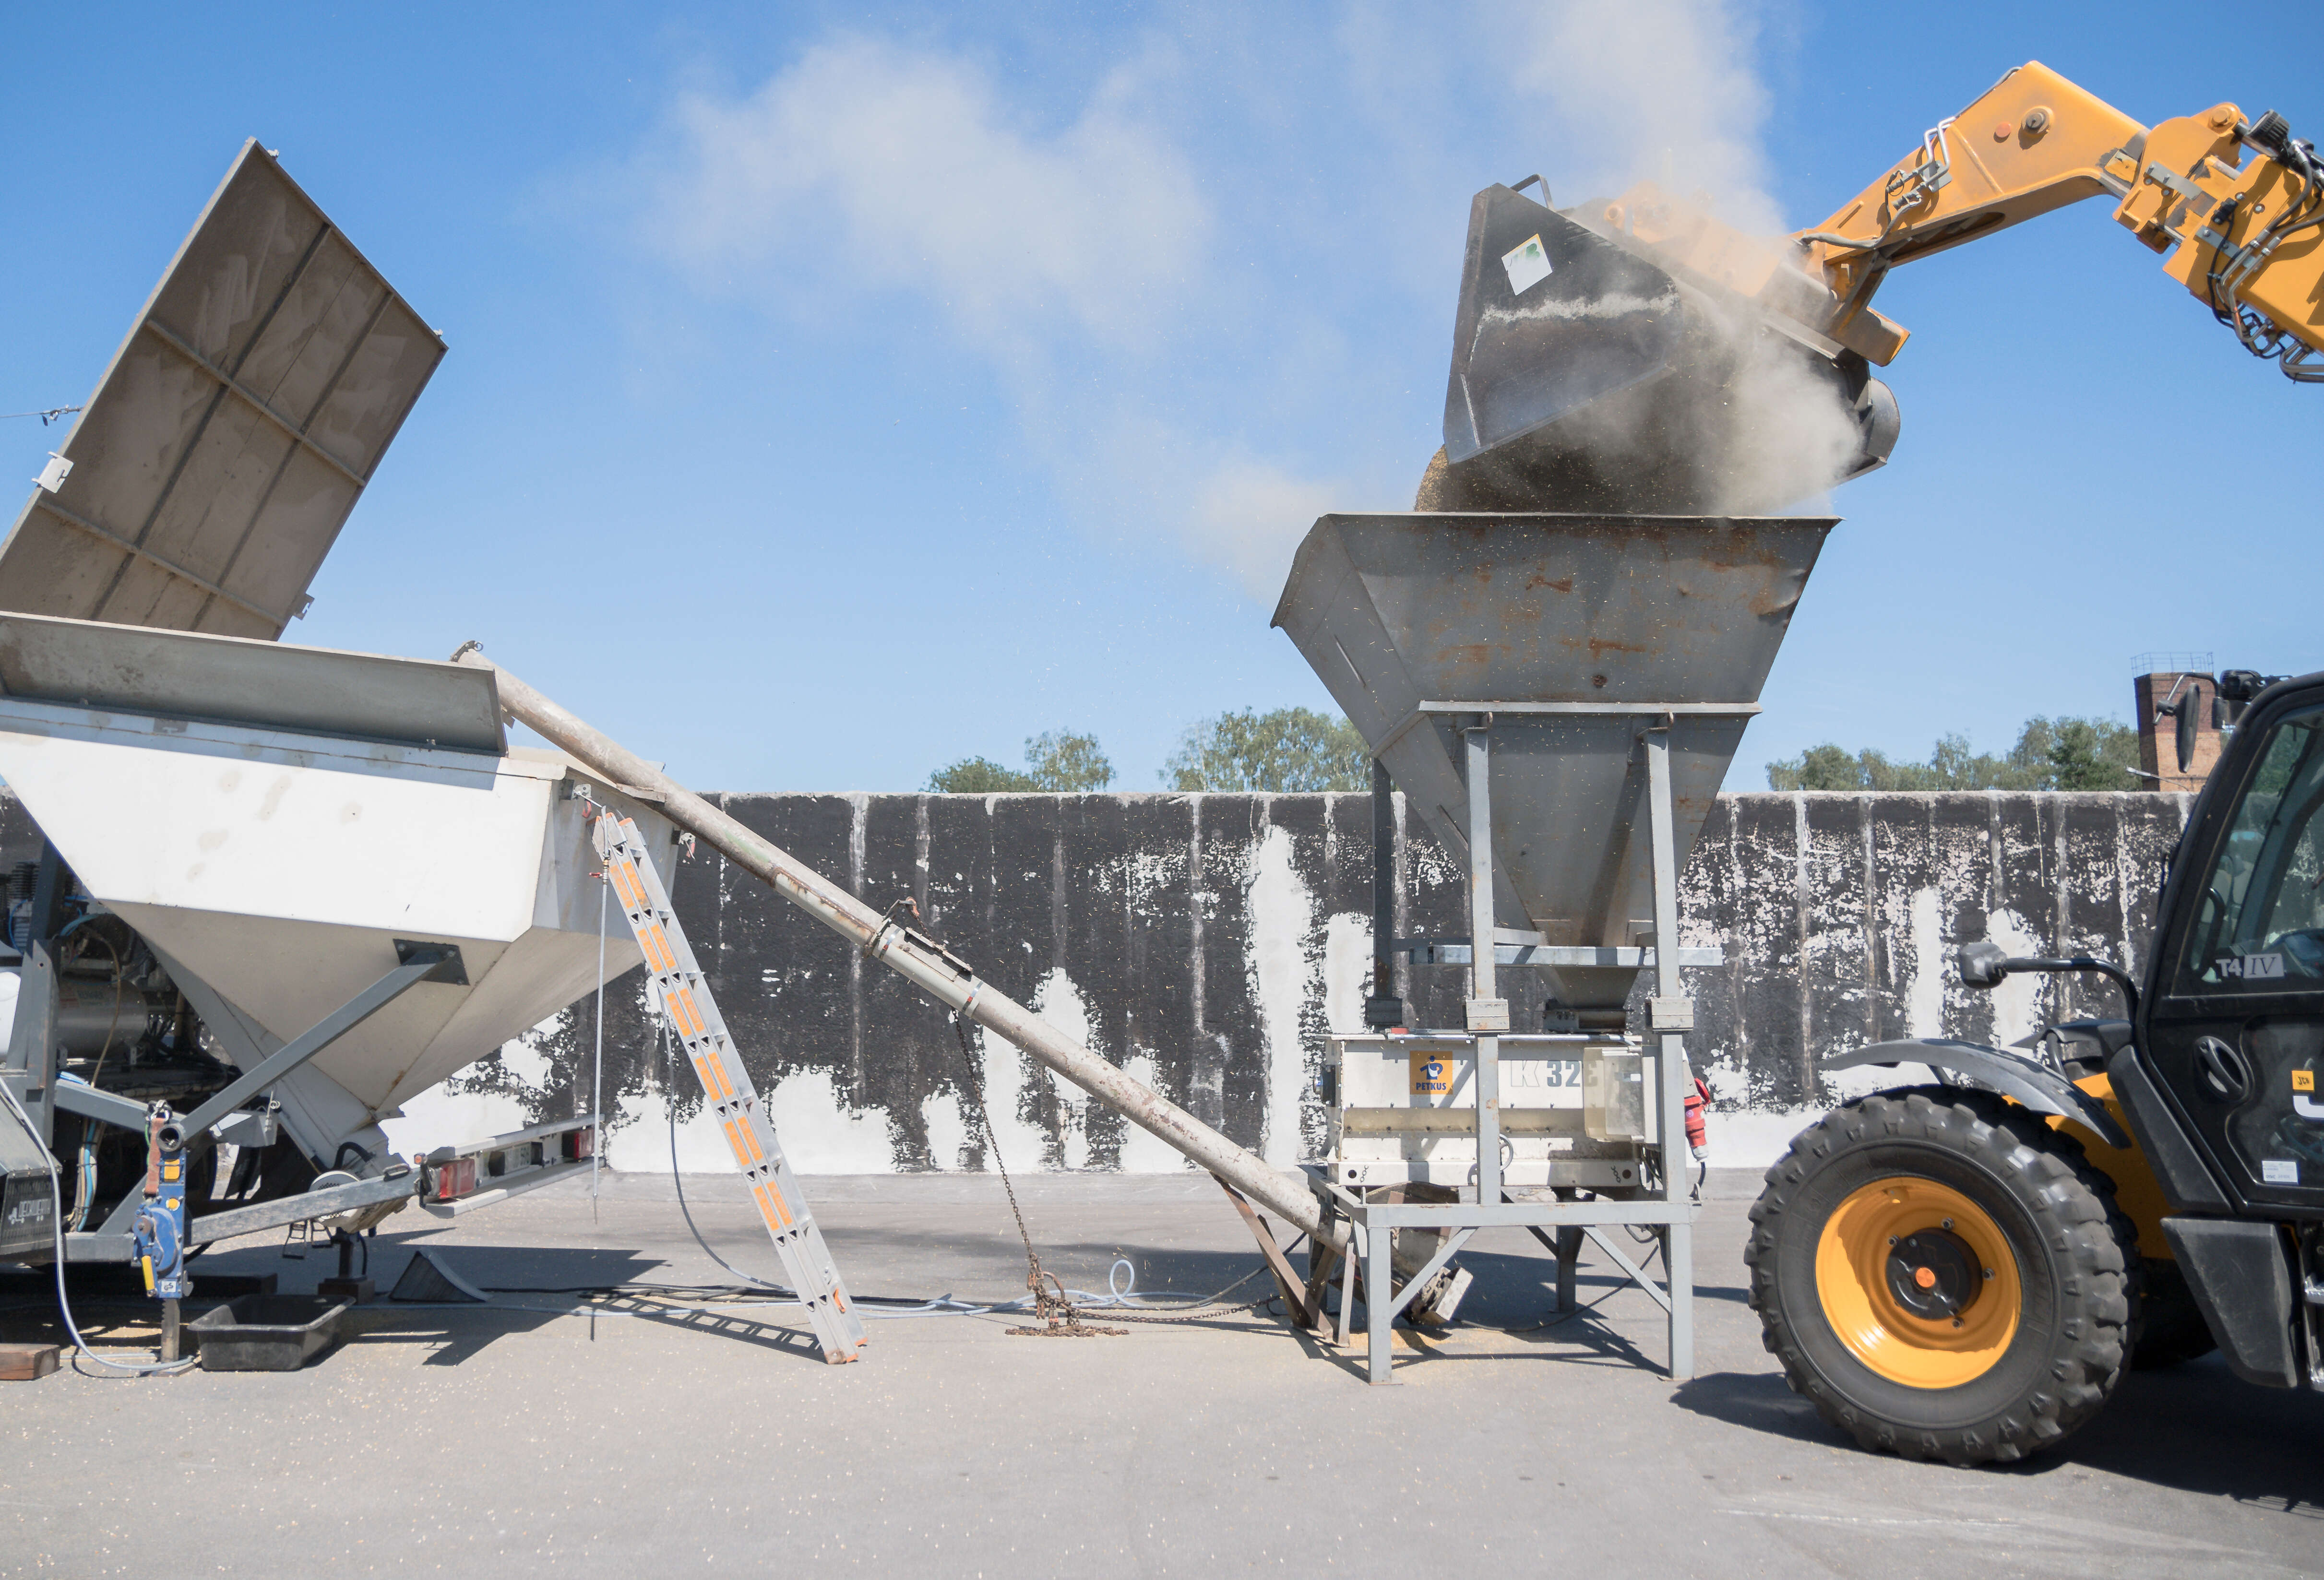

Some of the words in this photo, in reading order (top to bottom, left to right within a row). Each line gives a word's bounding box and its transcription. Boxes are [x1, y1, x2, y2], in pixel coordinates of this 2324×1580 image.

[2216, 958, 2242, 977] T4
[2249, 957, 2276, 974] IV
[1511, 1060, 1540, 1087] K
[1416, 1082, 1447, 1091] PETKUS
